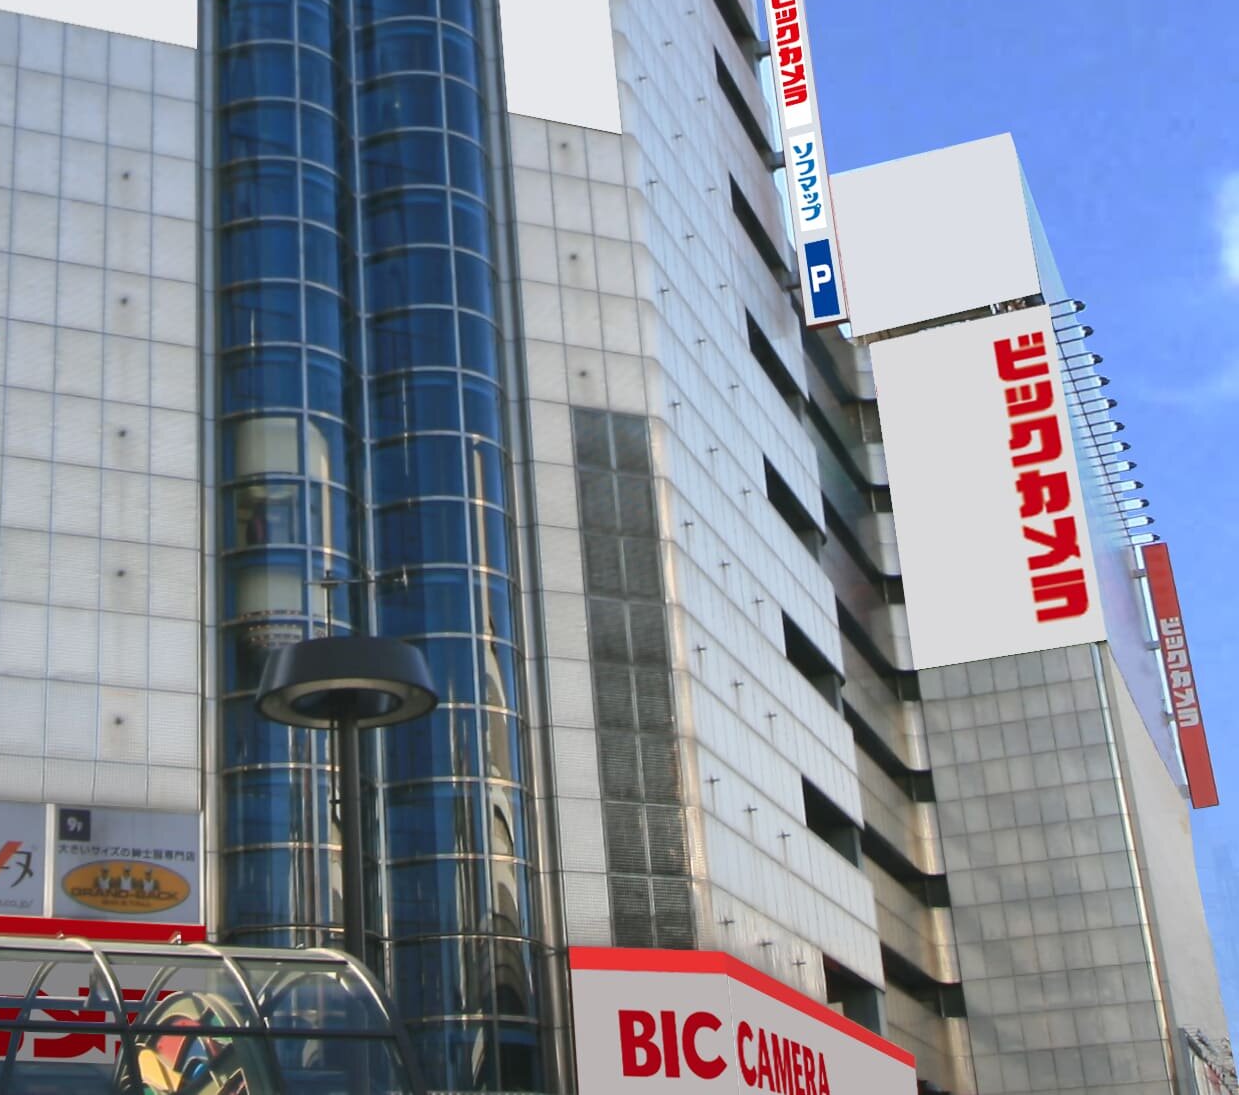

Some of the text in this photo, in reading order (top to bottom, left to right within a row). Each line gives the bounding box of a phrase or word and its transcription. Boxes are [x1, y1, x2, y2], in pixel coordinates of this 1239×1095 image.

[792, 141, 822, 222] ソフマップ
[810, 264, 831, 293] P
[994, 331, 1088, 623] ビックカメラ
[1160, 616, 1199, 728] ビックカメラ
[618, 1009, 830, 1095] BIC CAMERA
